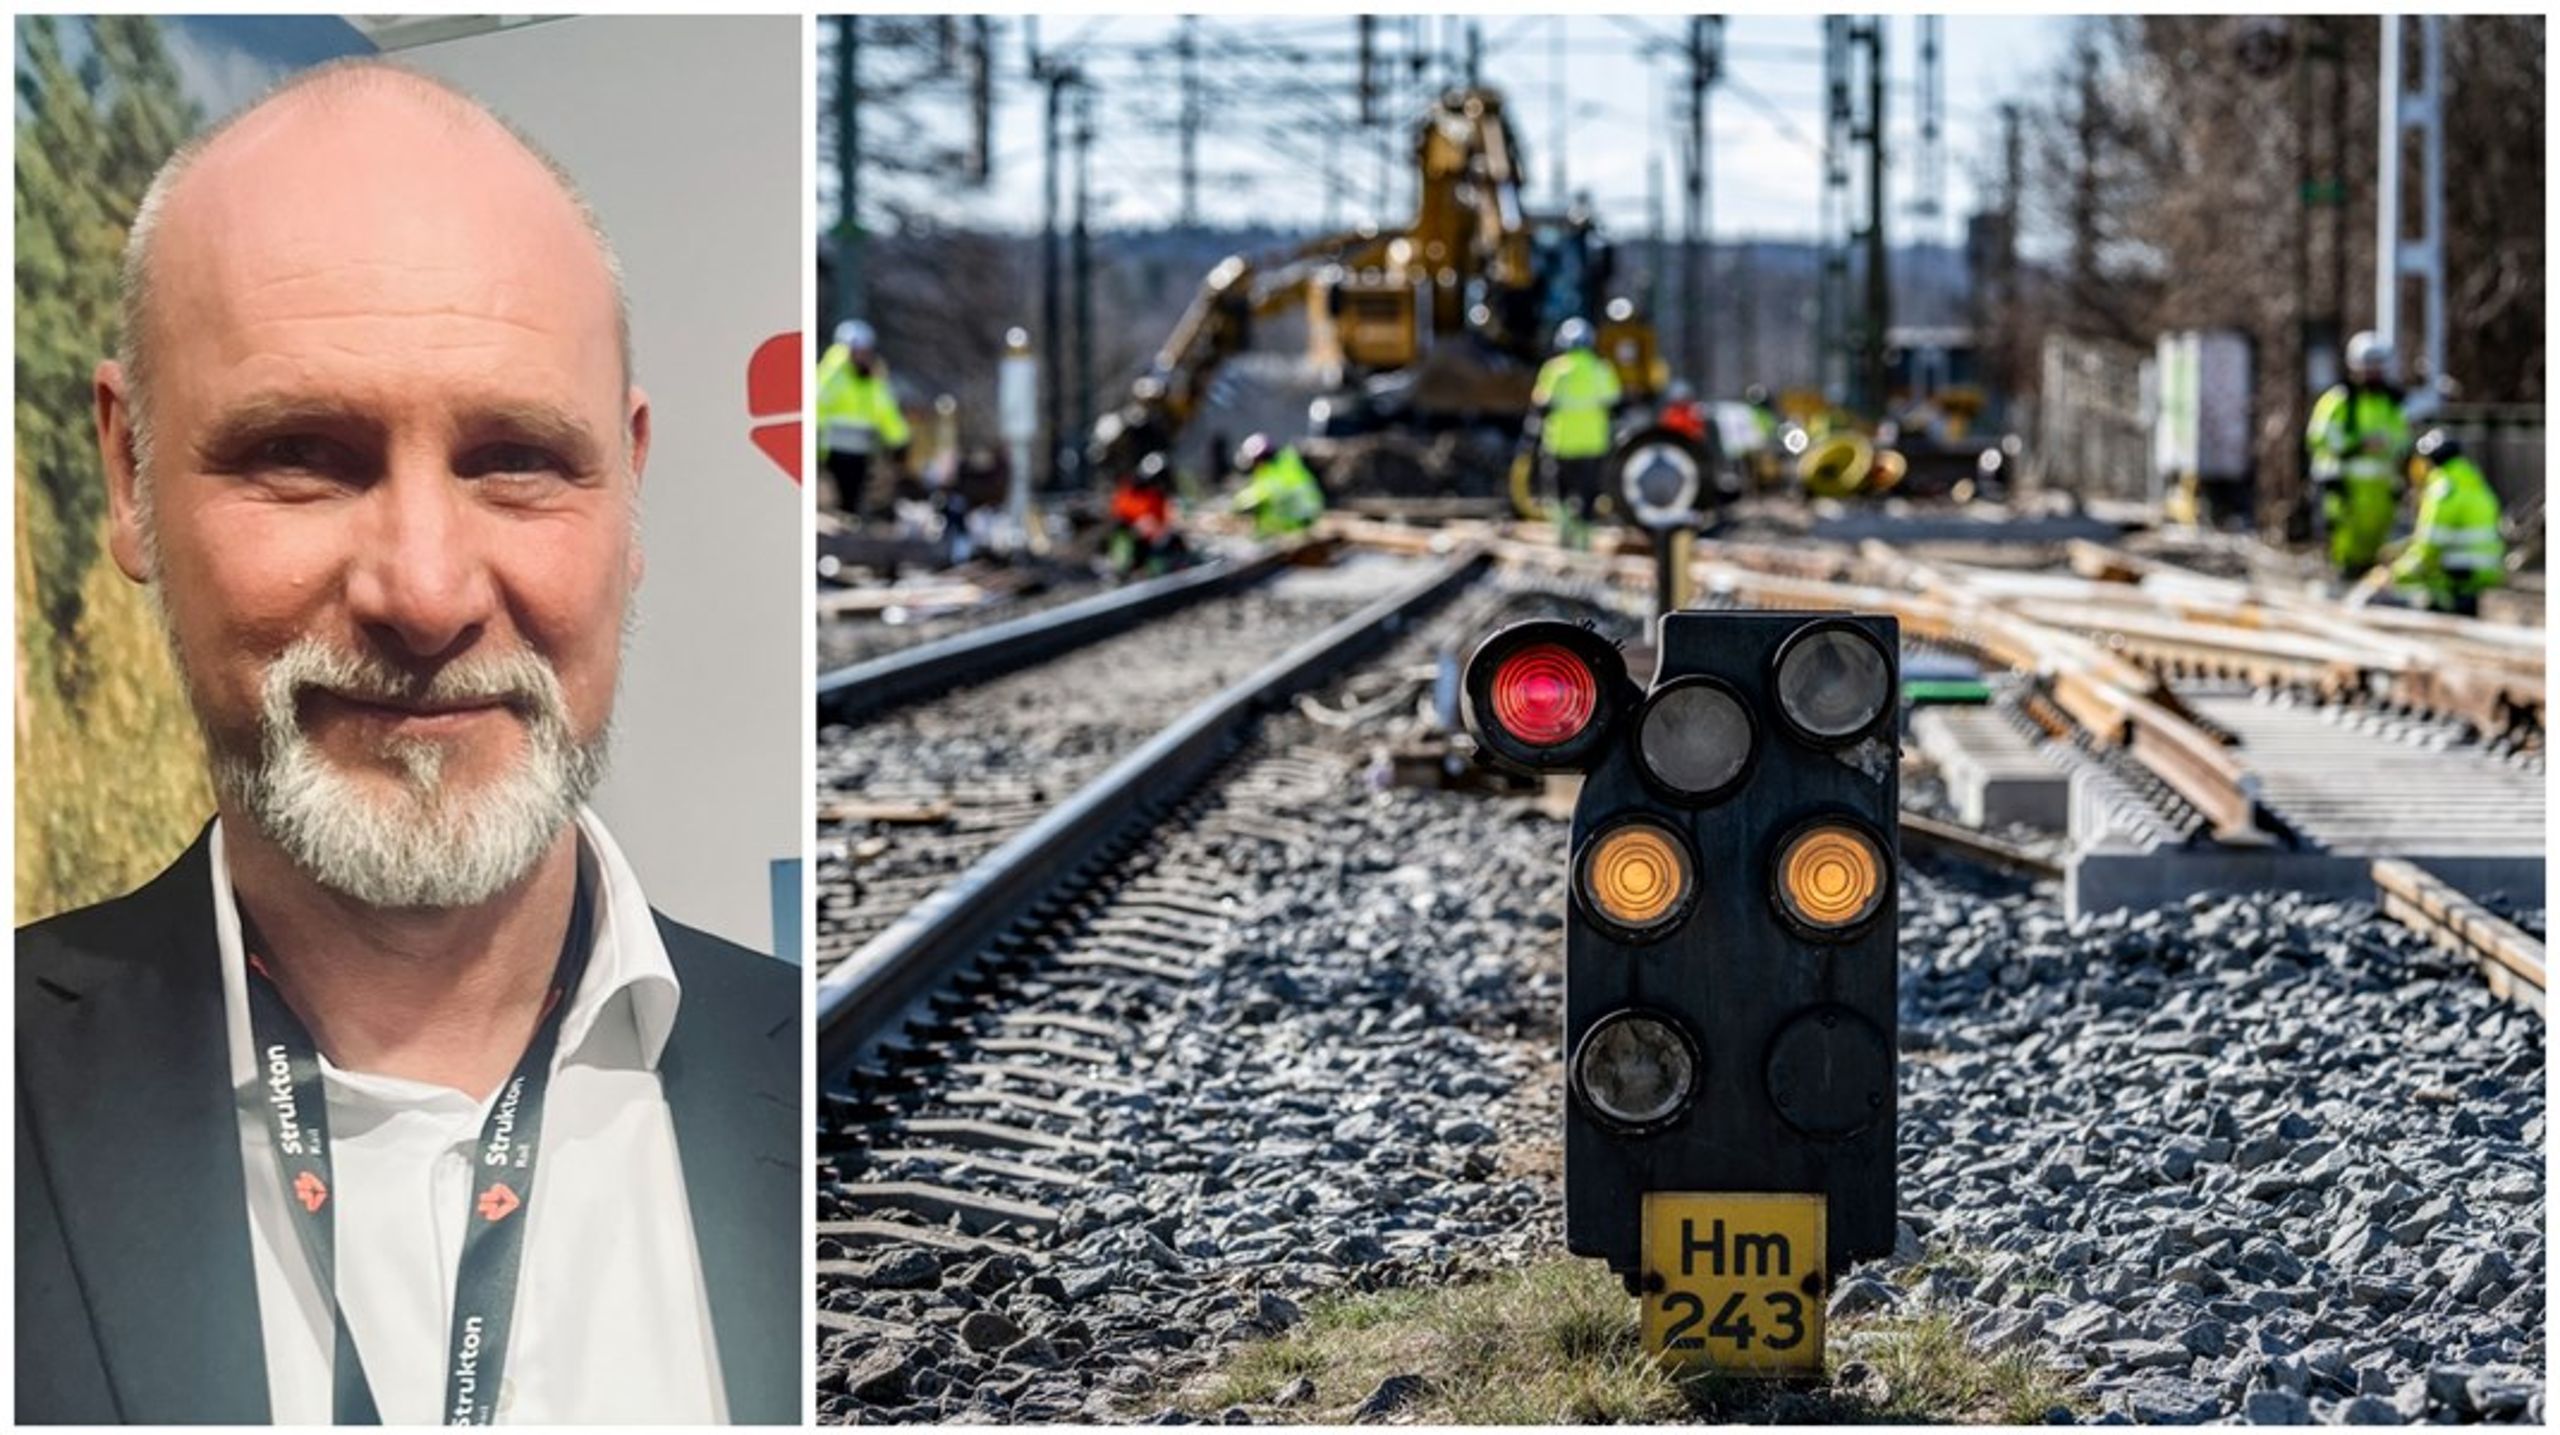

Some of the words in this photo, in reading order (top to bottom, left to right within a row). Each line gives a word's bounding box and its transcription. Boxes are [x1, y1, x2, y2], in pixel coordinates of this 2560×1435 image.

[267, 1044, 303, 1154] Strukton
[485, 1076, 526, 1166] Strukton
[1681, 1219, 1791, 1276] Hm
[1661, 1291, 1804, 1350] 243
